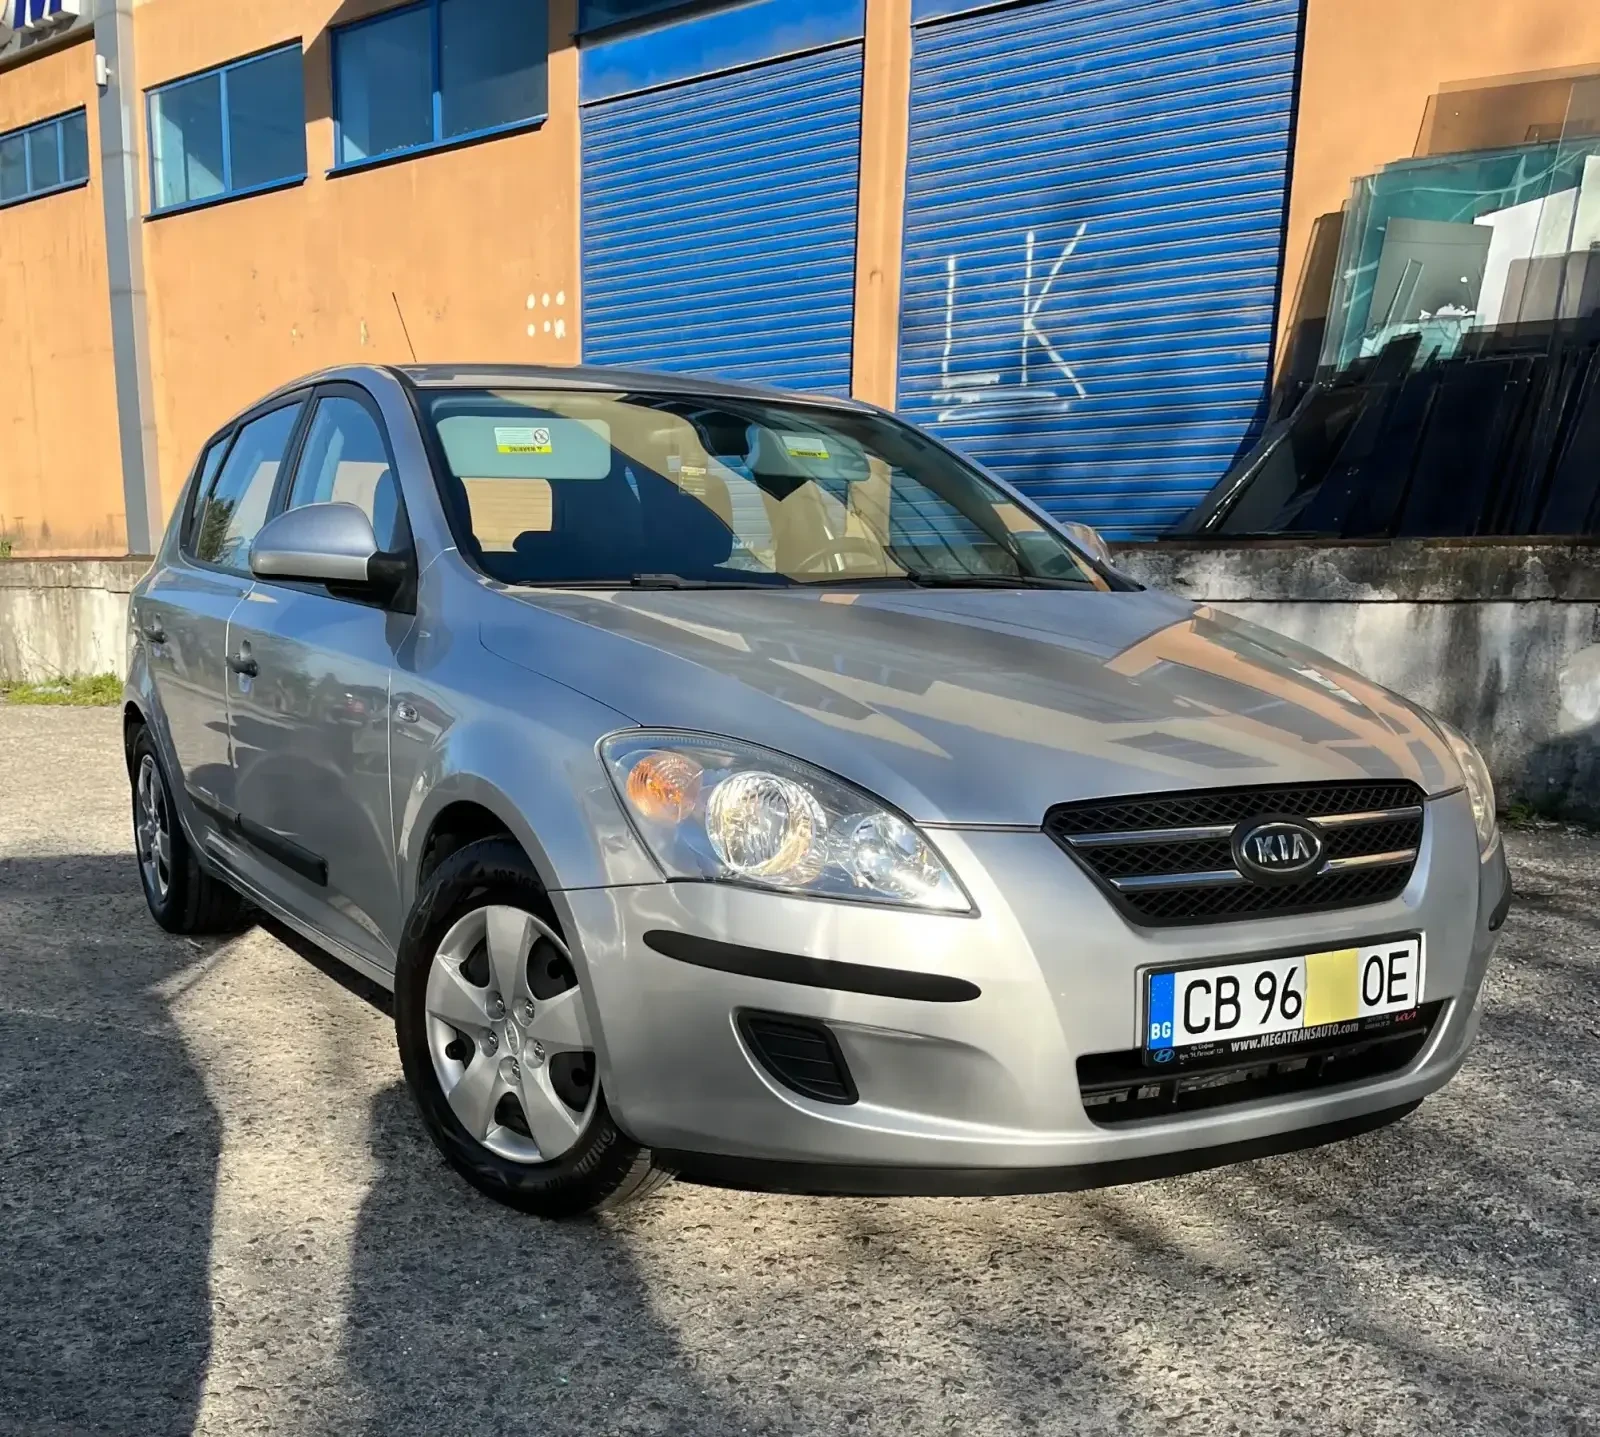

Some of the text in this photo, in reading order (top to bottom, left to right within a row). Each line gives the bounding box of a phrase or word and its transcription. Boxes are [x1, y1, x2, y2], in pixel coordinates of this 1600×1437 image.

[1254, 832, 1311, 864] KIA
[1183, 973, 1241, 1035] CB
[1150, 1021, 1172, 1040] BG
